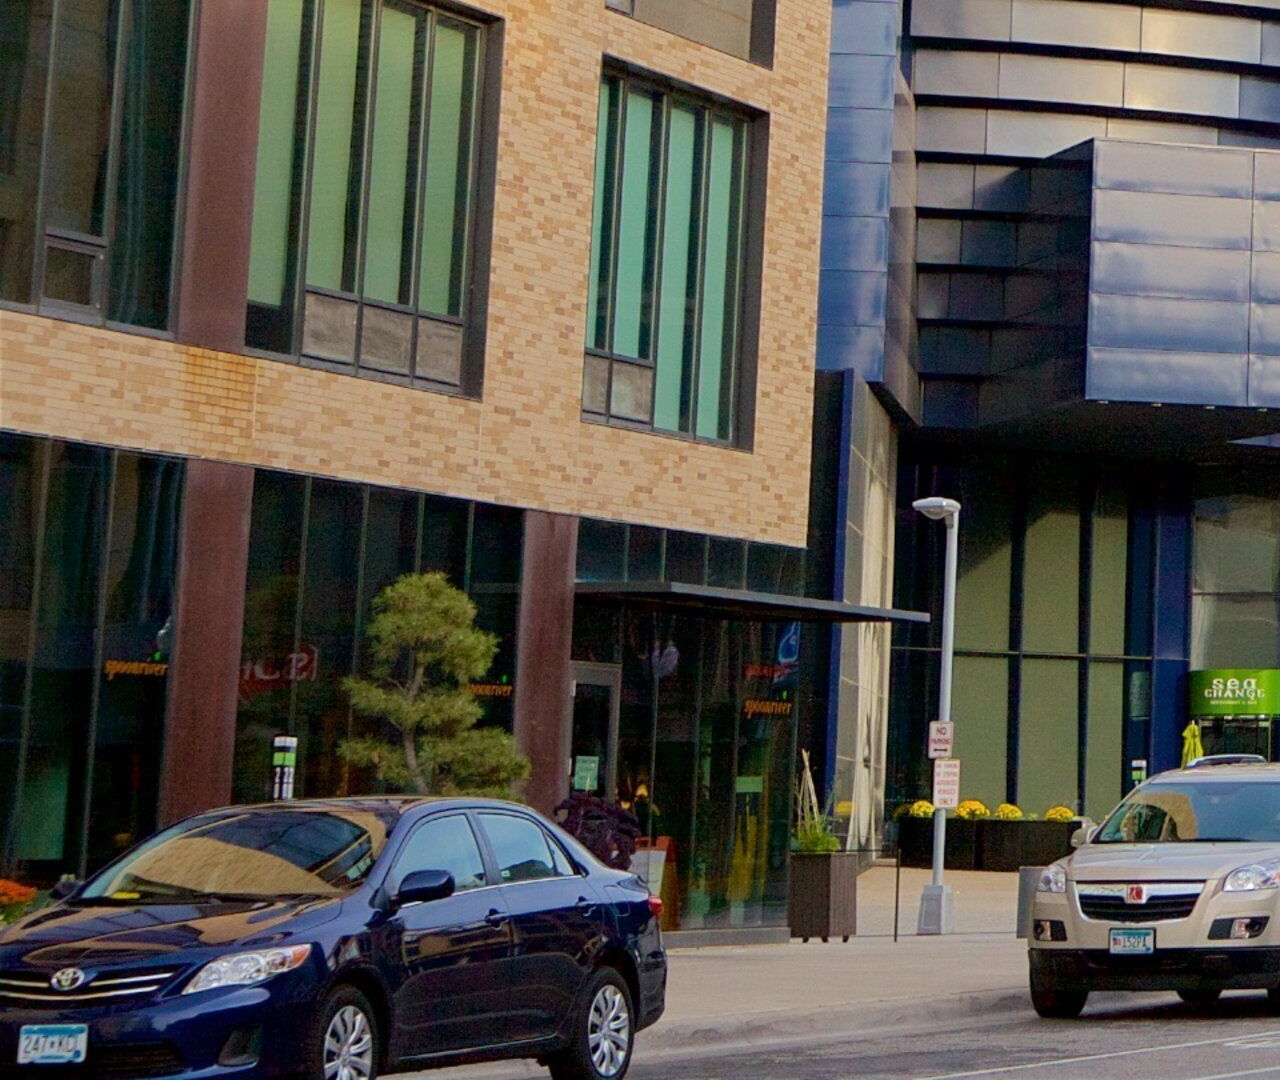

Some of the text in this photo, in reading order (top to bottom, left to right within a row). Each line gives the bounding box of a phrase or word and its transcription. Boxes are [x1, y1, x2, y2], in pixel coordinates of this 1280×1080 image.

[1211, 678, 1258, 690] sea
[1203, 688, 1266, 700] CHANGE
[936, 726, 947, 736] NO
